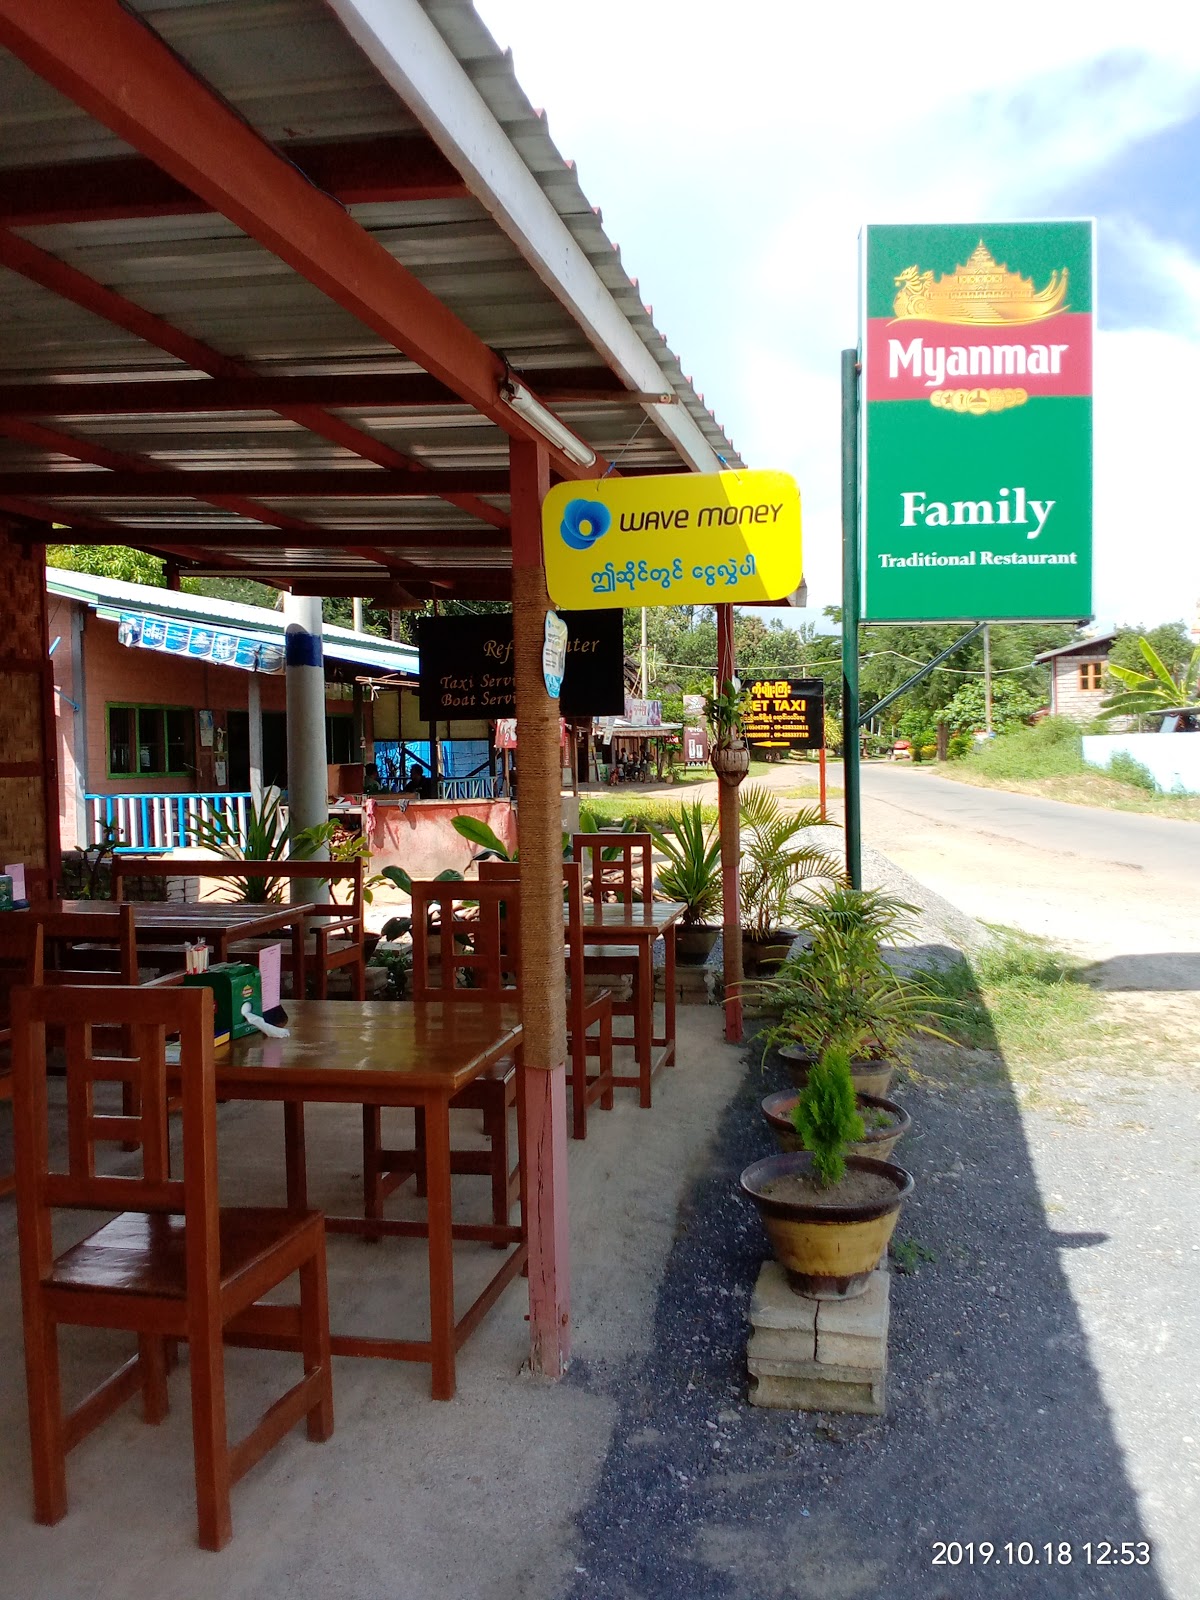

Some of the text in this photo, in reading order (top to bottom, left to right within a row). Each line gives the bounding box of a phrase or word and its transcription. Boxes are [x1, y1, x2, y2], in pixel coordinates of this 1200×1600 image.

[888, 337, 1069, 386] Myanmar
[899, 487, 1057, 540] Family
[878, 551, 1077, 568] Traditional Restaurant
[440, 673, 516, 692] Taxi Servi
[441, 691, 517, 706] Boat Servi
[773, 700, 806, 711] TAXI
